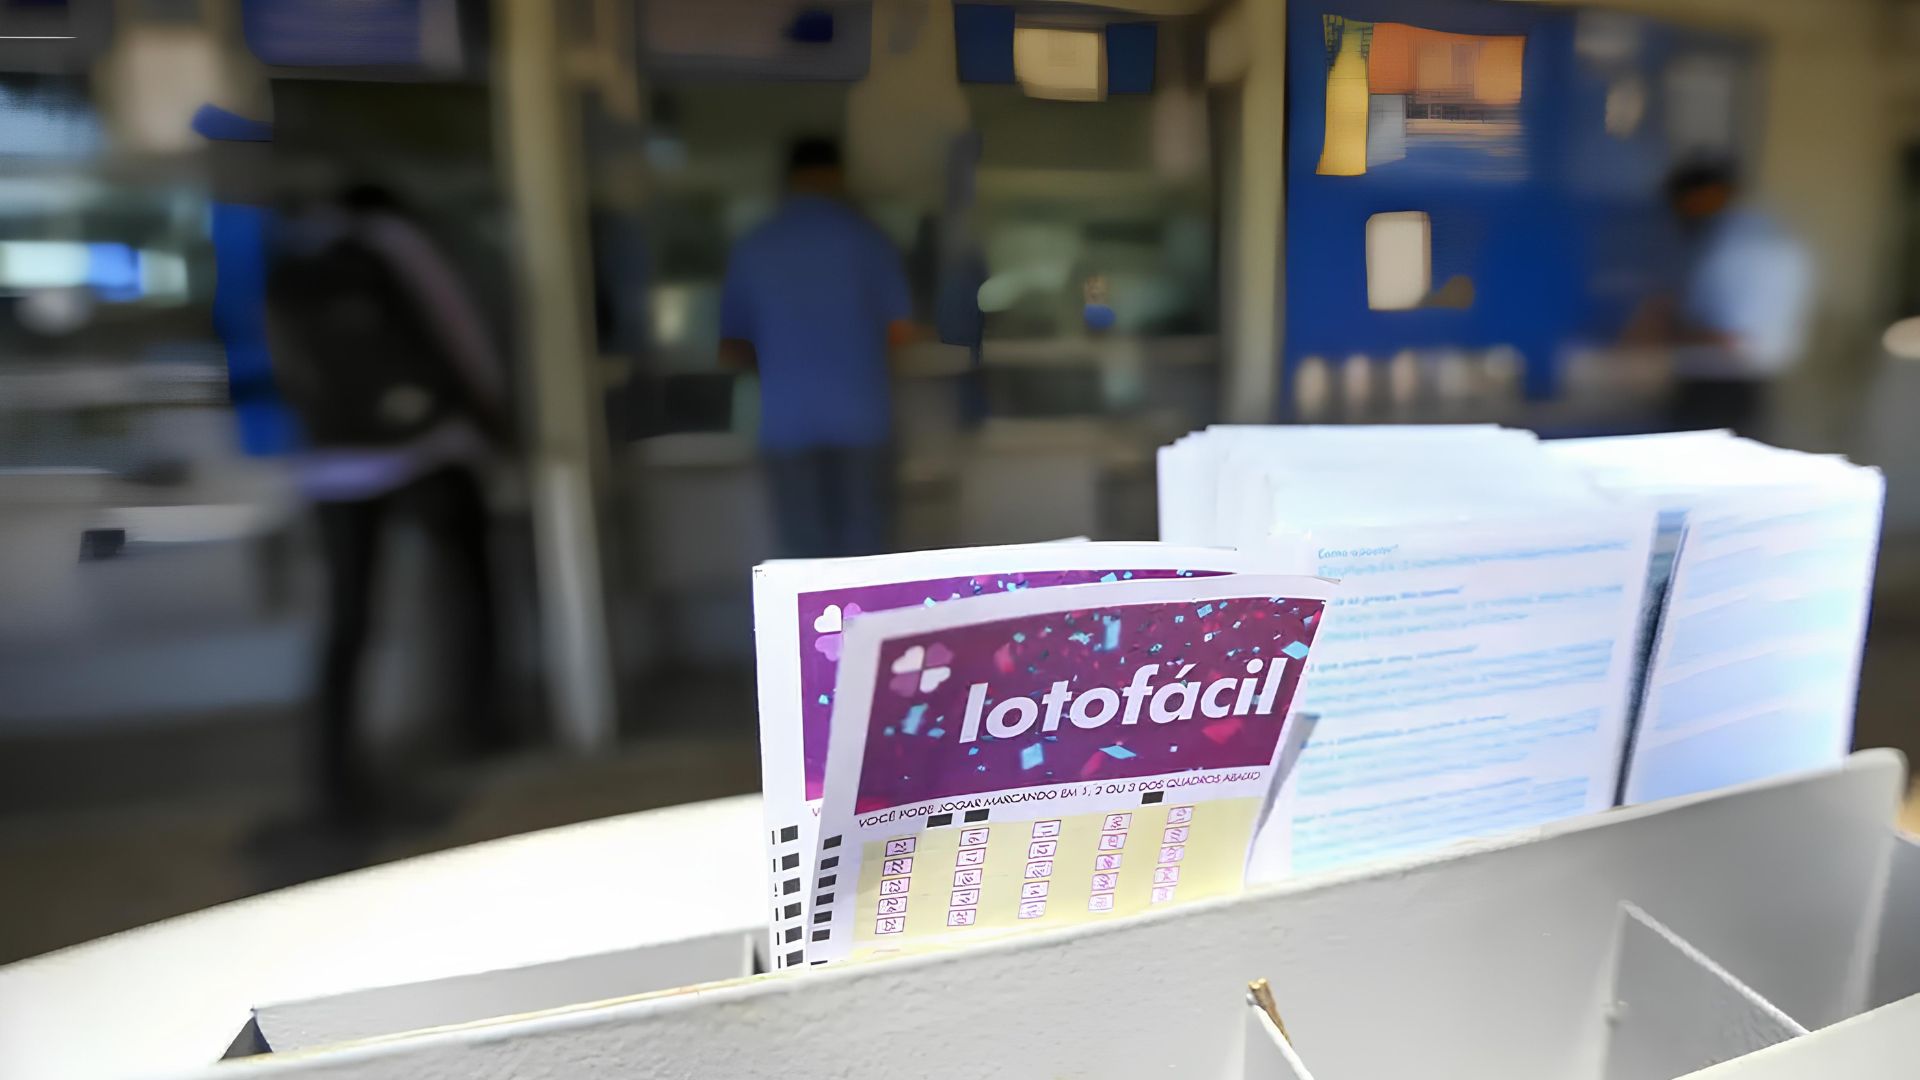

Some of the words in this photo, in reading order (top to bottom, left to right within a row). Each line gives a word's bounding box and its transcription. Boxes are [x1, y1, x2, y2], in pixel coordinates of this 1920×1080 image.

[959, 657, 1289, 744] lotofácil
[1106, 784, 1126, 795] OU
[1138, 780, 1165, 792] DOS
